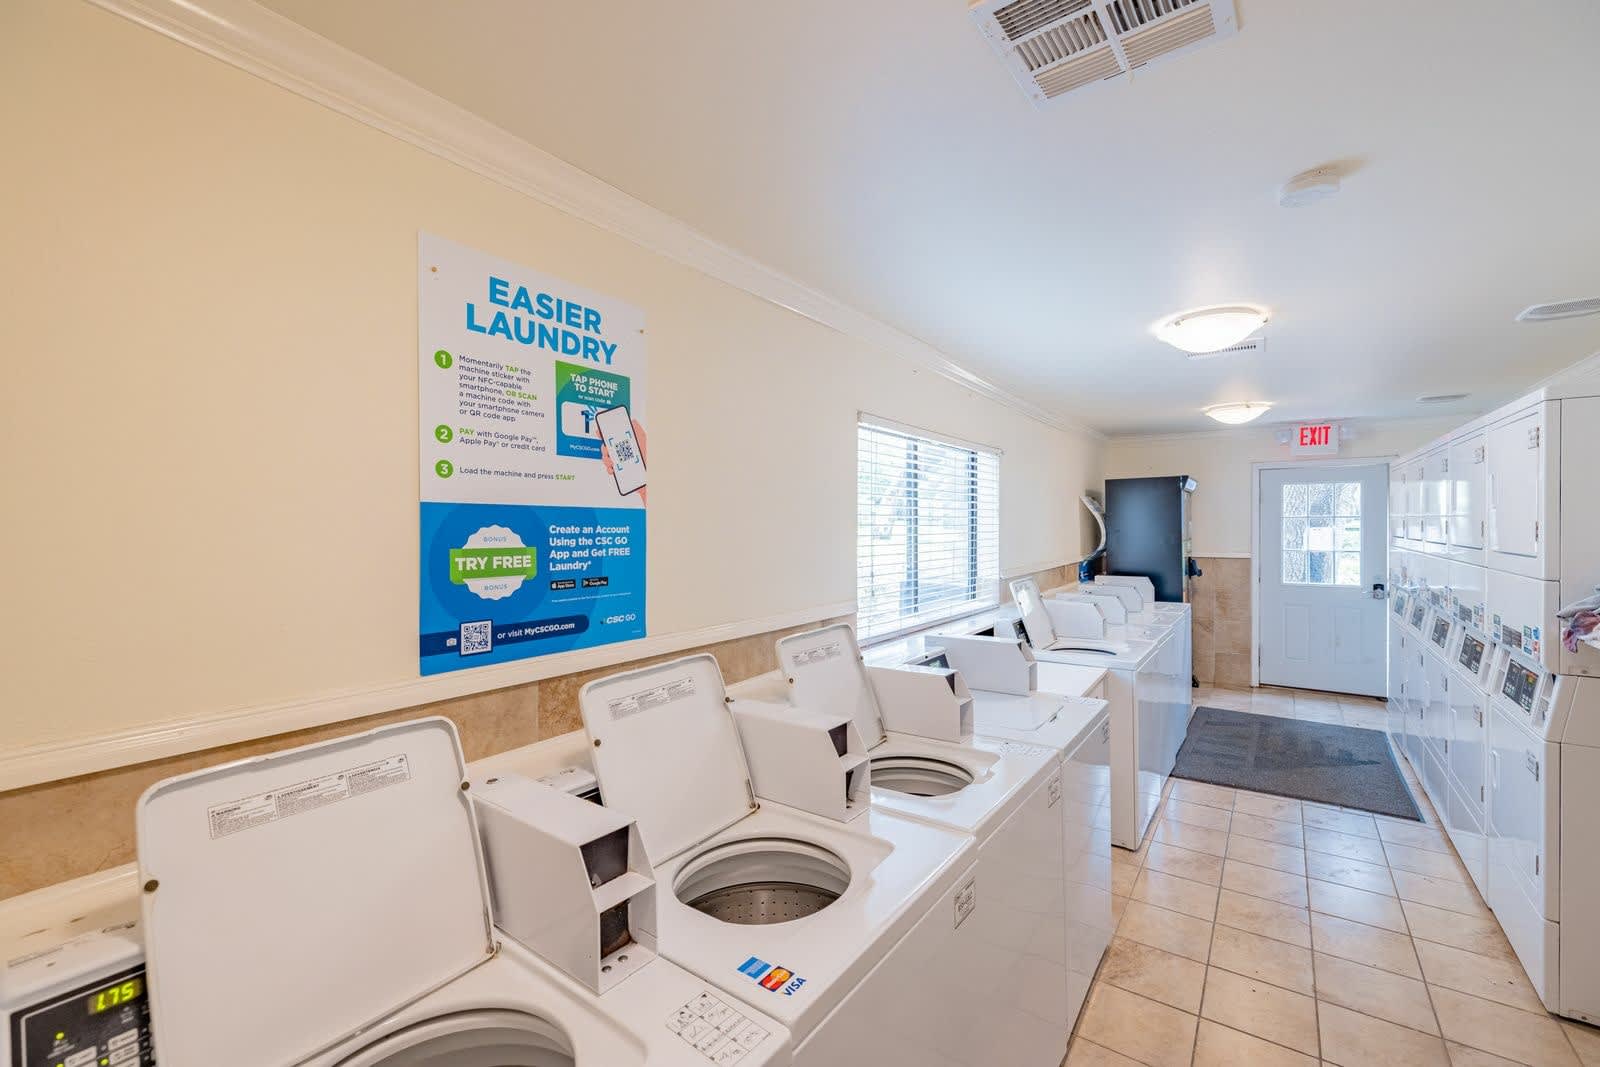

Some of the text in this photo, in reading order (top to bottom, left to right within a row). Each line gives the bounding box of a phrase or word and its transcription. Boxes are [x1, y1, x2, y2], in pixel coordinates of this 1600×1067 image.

[489, 276, 602, 334] EASIER
[466, 303, 617, 365] LAUNDRY
[440, 354, 446, 365] 1
[459, 355, 531, 376] Momentarily TAP the
[459, 365, 489, 375] machine
[492, 371, 514, 380] sticker
[478, 376, 522, 390] NFC-capable
[570, 373, 618, 391] TAP PHONE
[466, 392, 496, 402] machine
[518, 392, 537, 400] SCAN
[574, 382, 615, 398] TO START
[478, 403, 519, 415] smartphone
[521, 410, 545, 418] camera
[483, 411, 500, 419] code
[440, 429, 448, 440] 2
[459, 427, 474, 435] PAY
[494, 432, 519, 441] Google
[459, 436, 481, 445] Apple
[1299, 425, 1331, 446] EXIT
[440, 464, 448, 475] 3
[493, 469, 522, 477] machine
[549, 525, 630, 534] Create an Account
[549, 536, 628, 547] Using the CSC GO
[549, 547, 631, 560] App and Get FREE
[455, 555, 532, 571] TRY FREE
[606, 613, 636, 624] CSC GO
[508, 629, 523, 638] visit
[524, 623, 575, 636] MyCSCGO.com
[783, 977, 807, 996] VISA
